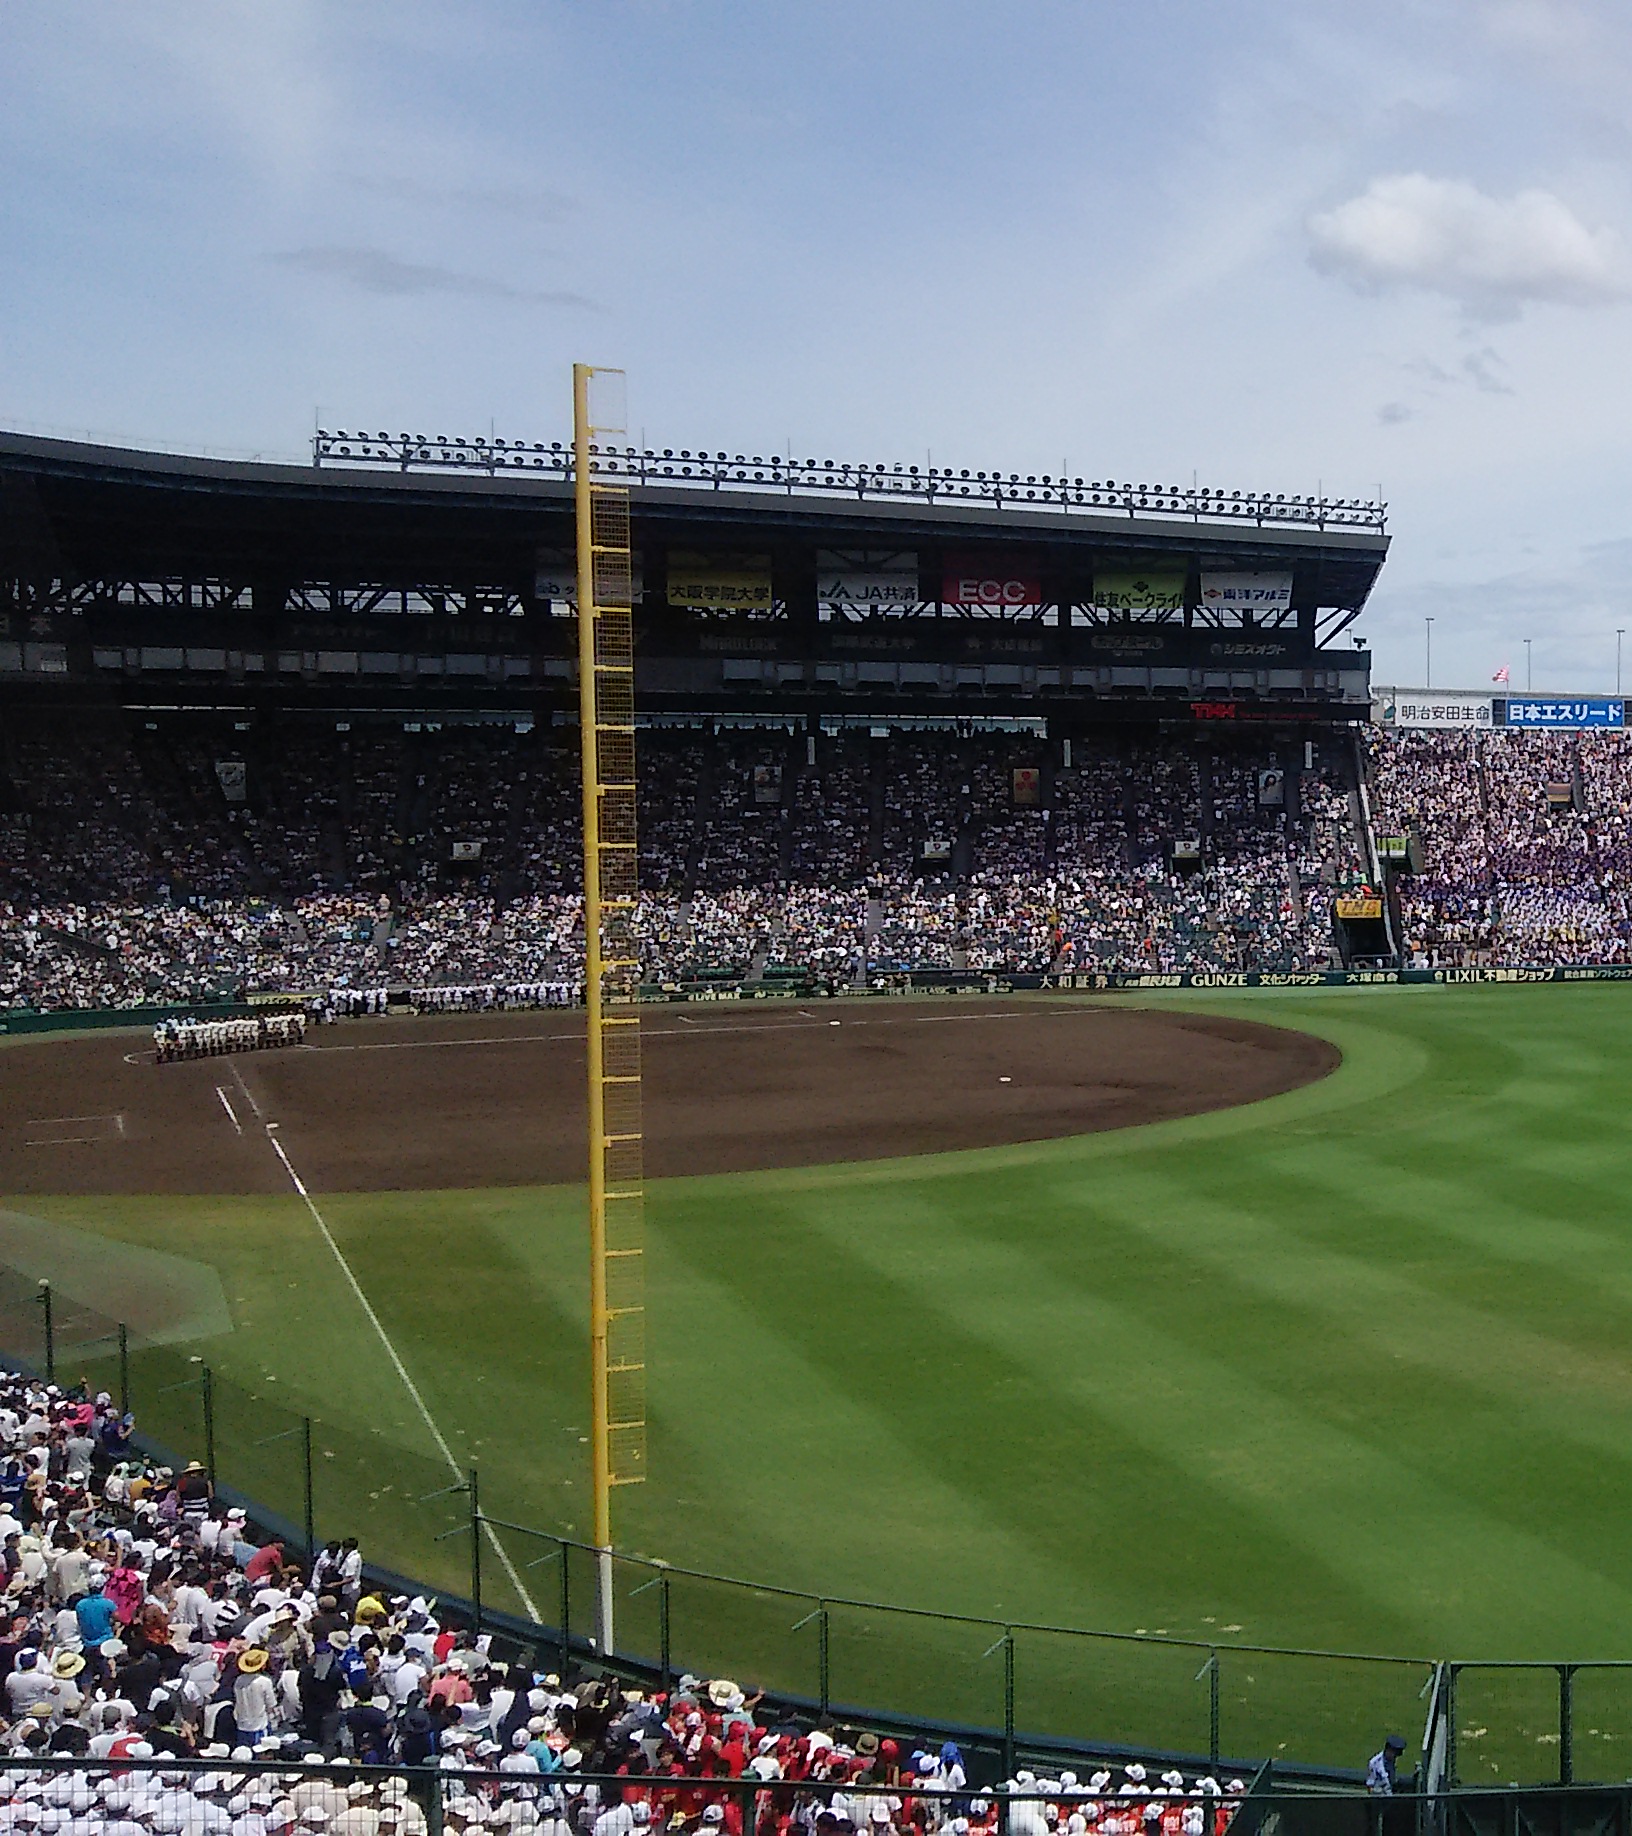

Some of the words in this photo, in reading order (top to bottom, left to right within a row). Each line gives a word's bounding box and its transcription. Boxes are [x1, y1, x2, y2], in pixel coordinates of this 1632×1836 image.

[856, 586, 916, 601] JA共済
[958, 579, 1026, 602] ECC
[1223, 643, 1287, 655] シミズオクト
[1401, 704, 1490, 721] 明治安田生命
[1509, 704, 1622, 721] 日本エスリード
[1039, 974, 1108, 989] 大和証券
[1191, 973, 1248, 986] GUNZE
[1346, 972, 1399, 983] 大塚商会
